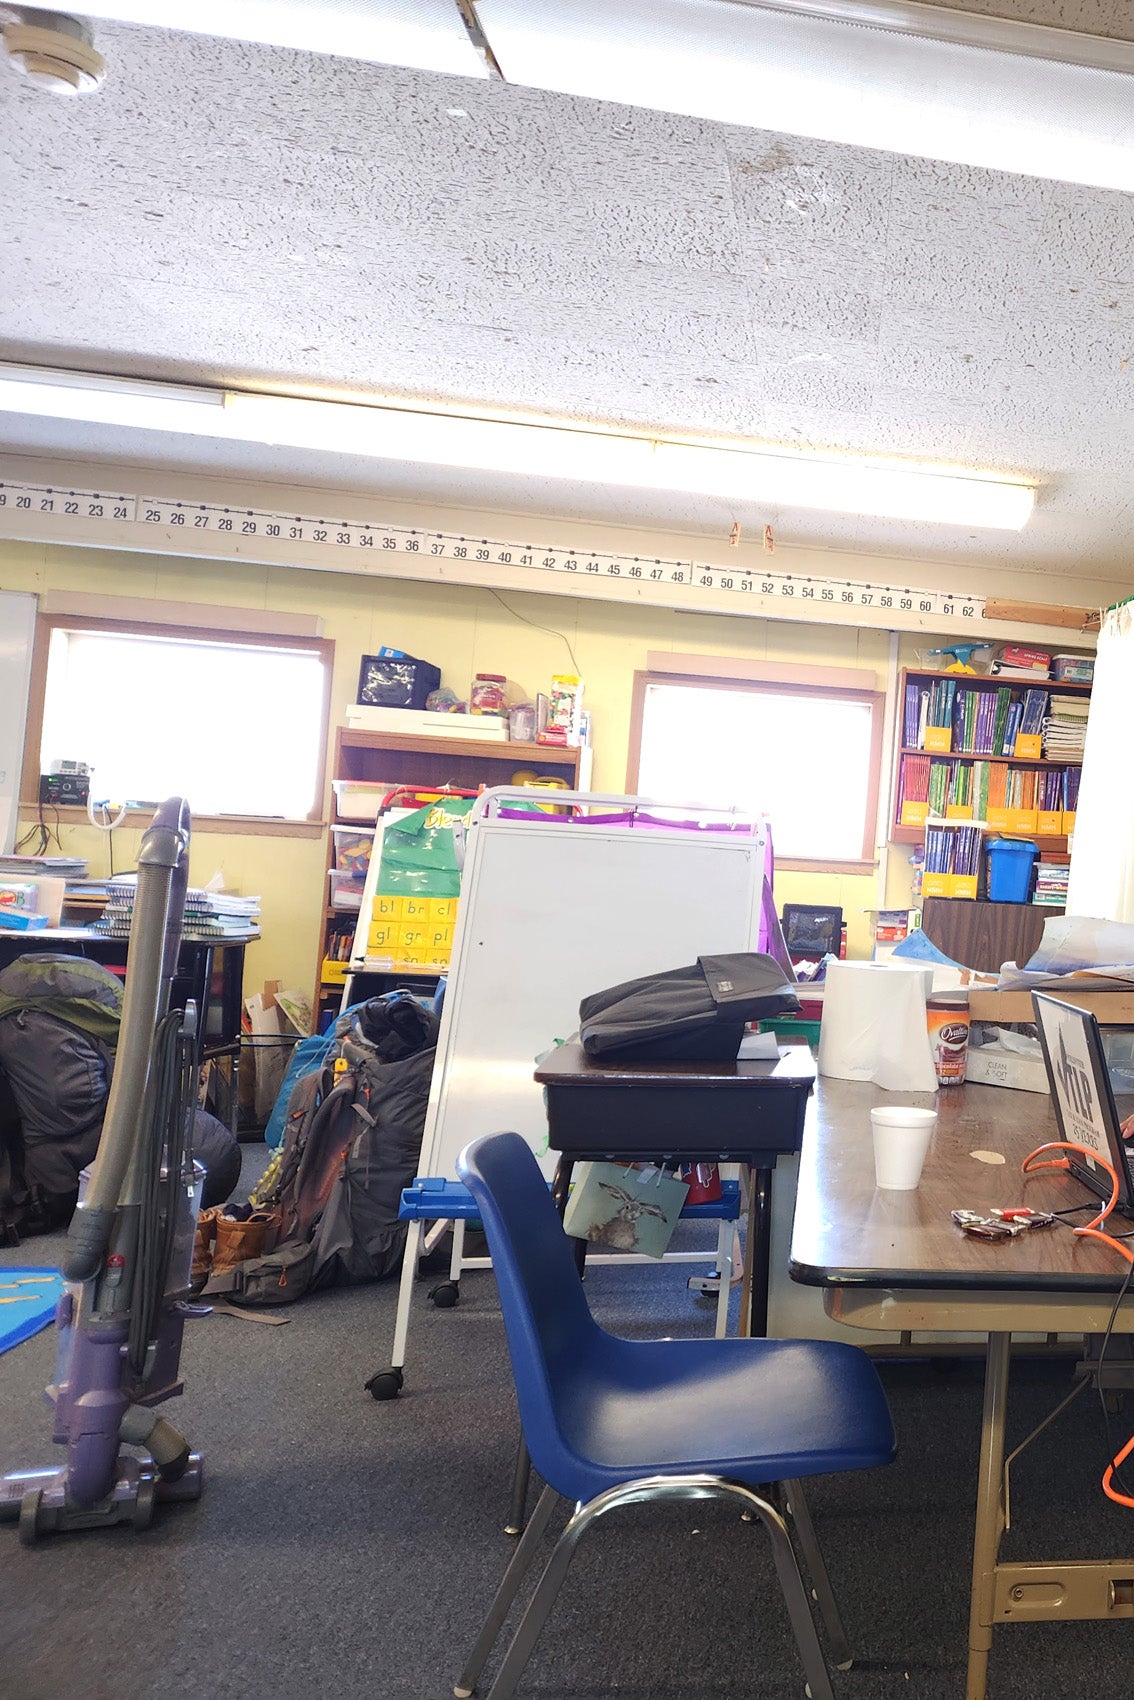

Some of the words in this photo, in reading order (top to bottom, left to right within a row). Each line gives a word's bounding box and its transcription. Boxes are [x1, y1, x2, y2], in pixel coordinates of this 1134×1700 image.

[16, 495, 31, 509] 20
[41, 498, 54, 512] 21
[65, 501, 79, 514] 22
[89, 503, 104, 517] 23
[114, 506, 127, 519] 24
[146, 509, 160, 522] 25
[170, 512, 185, 525] 26
[194, 515, 209, 528] 27
[218, 518, 232, 531] 28
[242, 520, 256, 533] 29
[266, 523, 280, 536] 30
[289, 526, 303, 539] 31
[313, 529, 327, 542] 32
[336, 532, 350, 545] 33
[360, 534, 373, 547] 34
[382, 537, 396, 550] 35
[405, 539, 419, 552] 36
[431, 543, 445, 556] 37
[453, 546, 467, 559] 38
[476, 549, 489, 561] 39
[498, 551, 511, 564] 40
[520, 554, 533, 566] 41
[542, 556, 555, 569] 42
[564, 559, 577, 571] 43
[585, 561, 599, 574] 44
[607, 564, 620, 576] 45
[629, 566, 642, 579] 46
[649, 569, 663, 581] 47
[671, 570, 684, 583] 48
[700, 574, 712, 586] 49
[721, 577, 733, 589] 50
[741, 579, 752, 591] 51
[762, 581, 774, 593] 52
[782, 584, 794, 596] 53
[802, 586, 814, 598] 54
[822, 588, 834, 600] 55
[842, 591, 853, 603] 56
[861, 593, 873, 605] 57
[881, 595, 892, 607] 58
[900, 598, 912, 610] 59
[919, 600, 931, 612] 60
[943, 603, 954, 616] 61
[963, 605, 974, 617] 62
[380, 900, 394, 913] bl
[408, 901, 424, 914] br
[438, 900, 450, 915] cl
[377, 927, 391, 946] gl
[405, 932, 421, 946] gr
[434, 928, 448, 947] pl
[988, 1061, 1007, 1071] CLEAN
